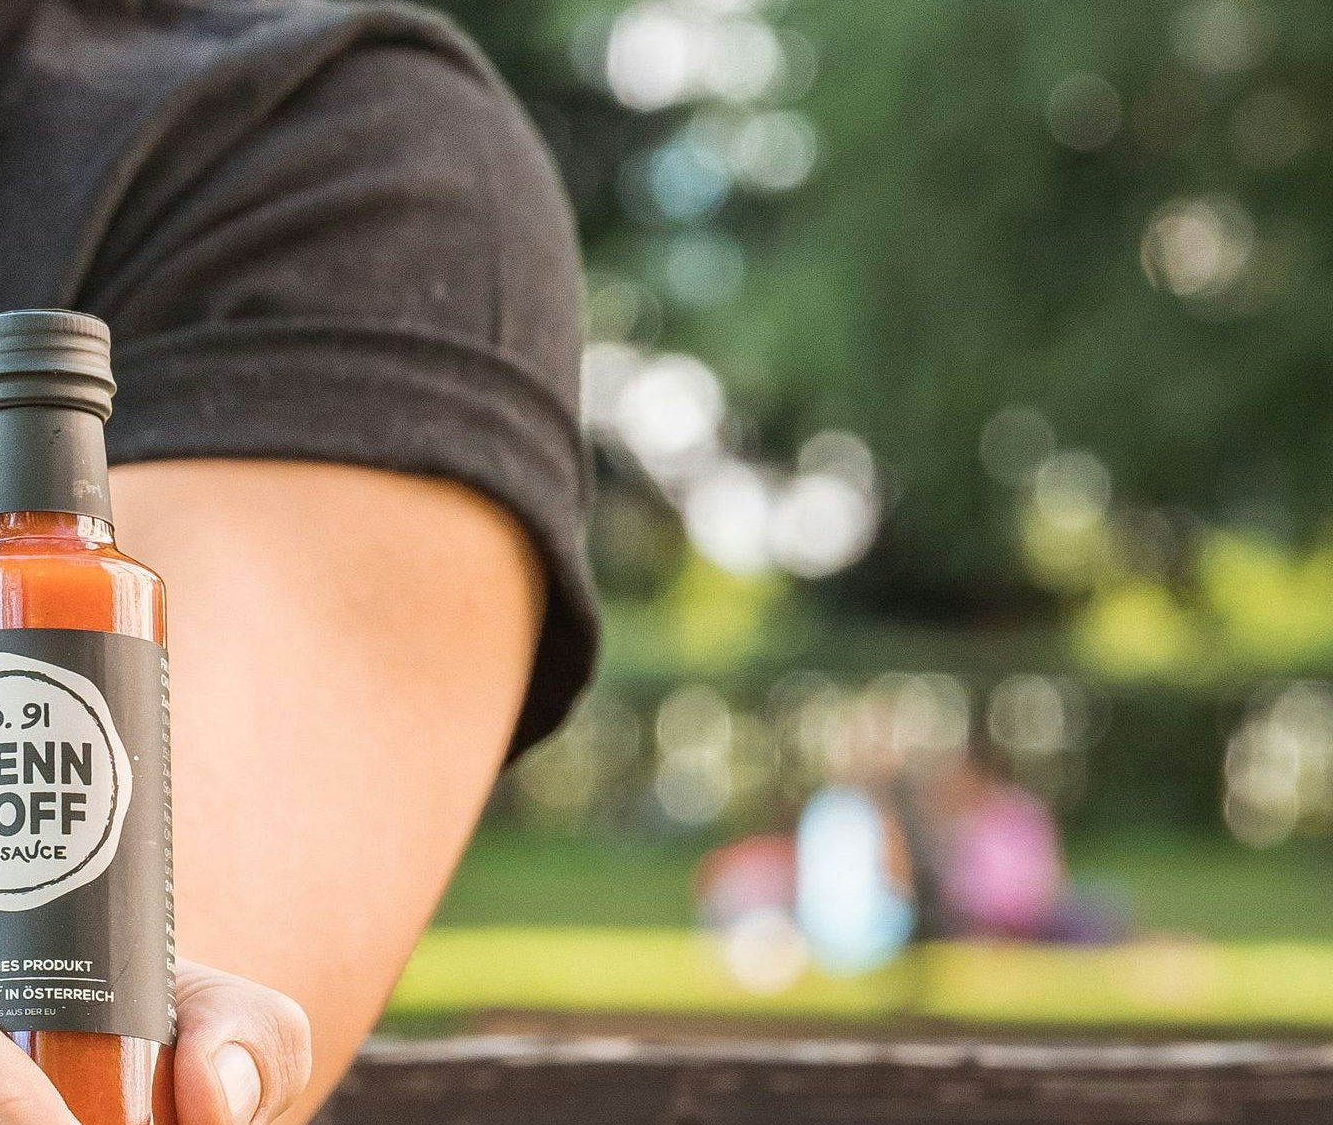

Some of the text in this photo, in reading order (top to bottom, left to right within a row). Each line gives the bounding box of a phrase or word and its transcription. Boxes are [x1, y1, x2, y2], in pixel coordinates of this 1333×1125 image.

[21, 703, 50, 730] 91
[0, 840, 68, 863] SAUCE
[23, 959, 93, 973] PRODUKT
[5, 988, 19, 1001] IN
[23, 985, 115, 1003] ÖSTERREICH
[6, 1008, 23, 1017] AUS
[24, 1008, 42, 1017] DER
[44, 1007, 57, 1017] EU
